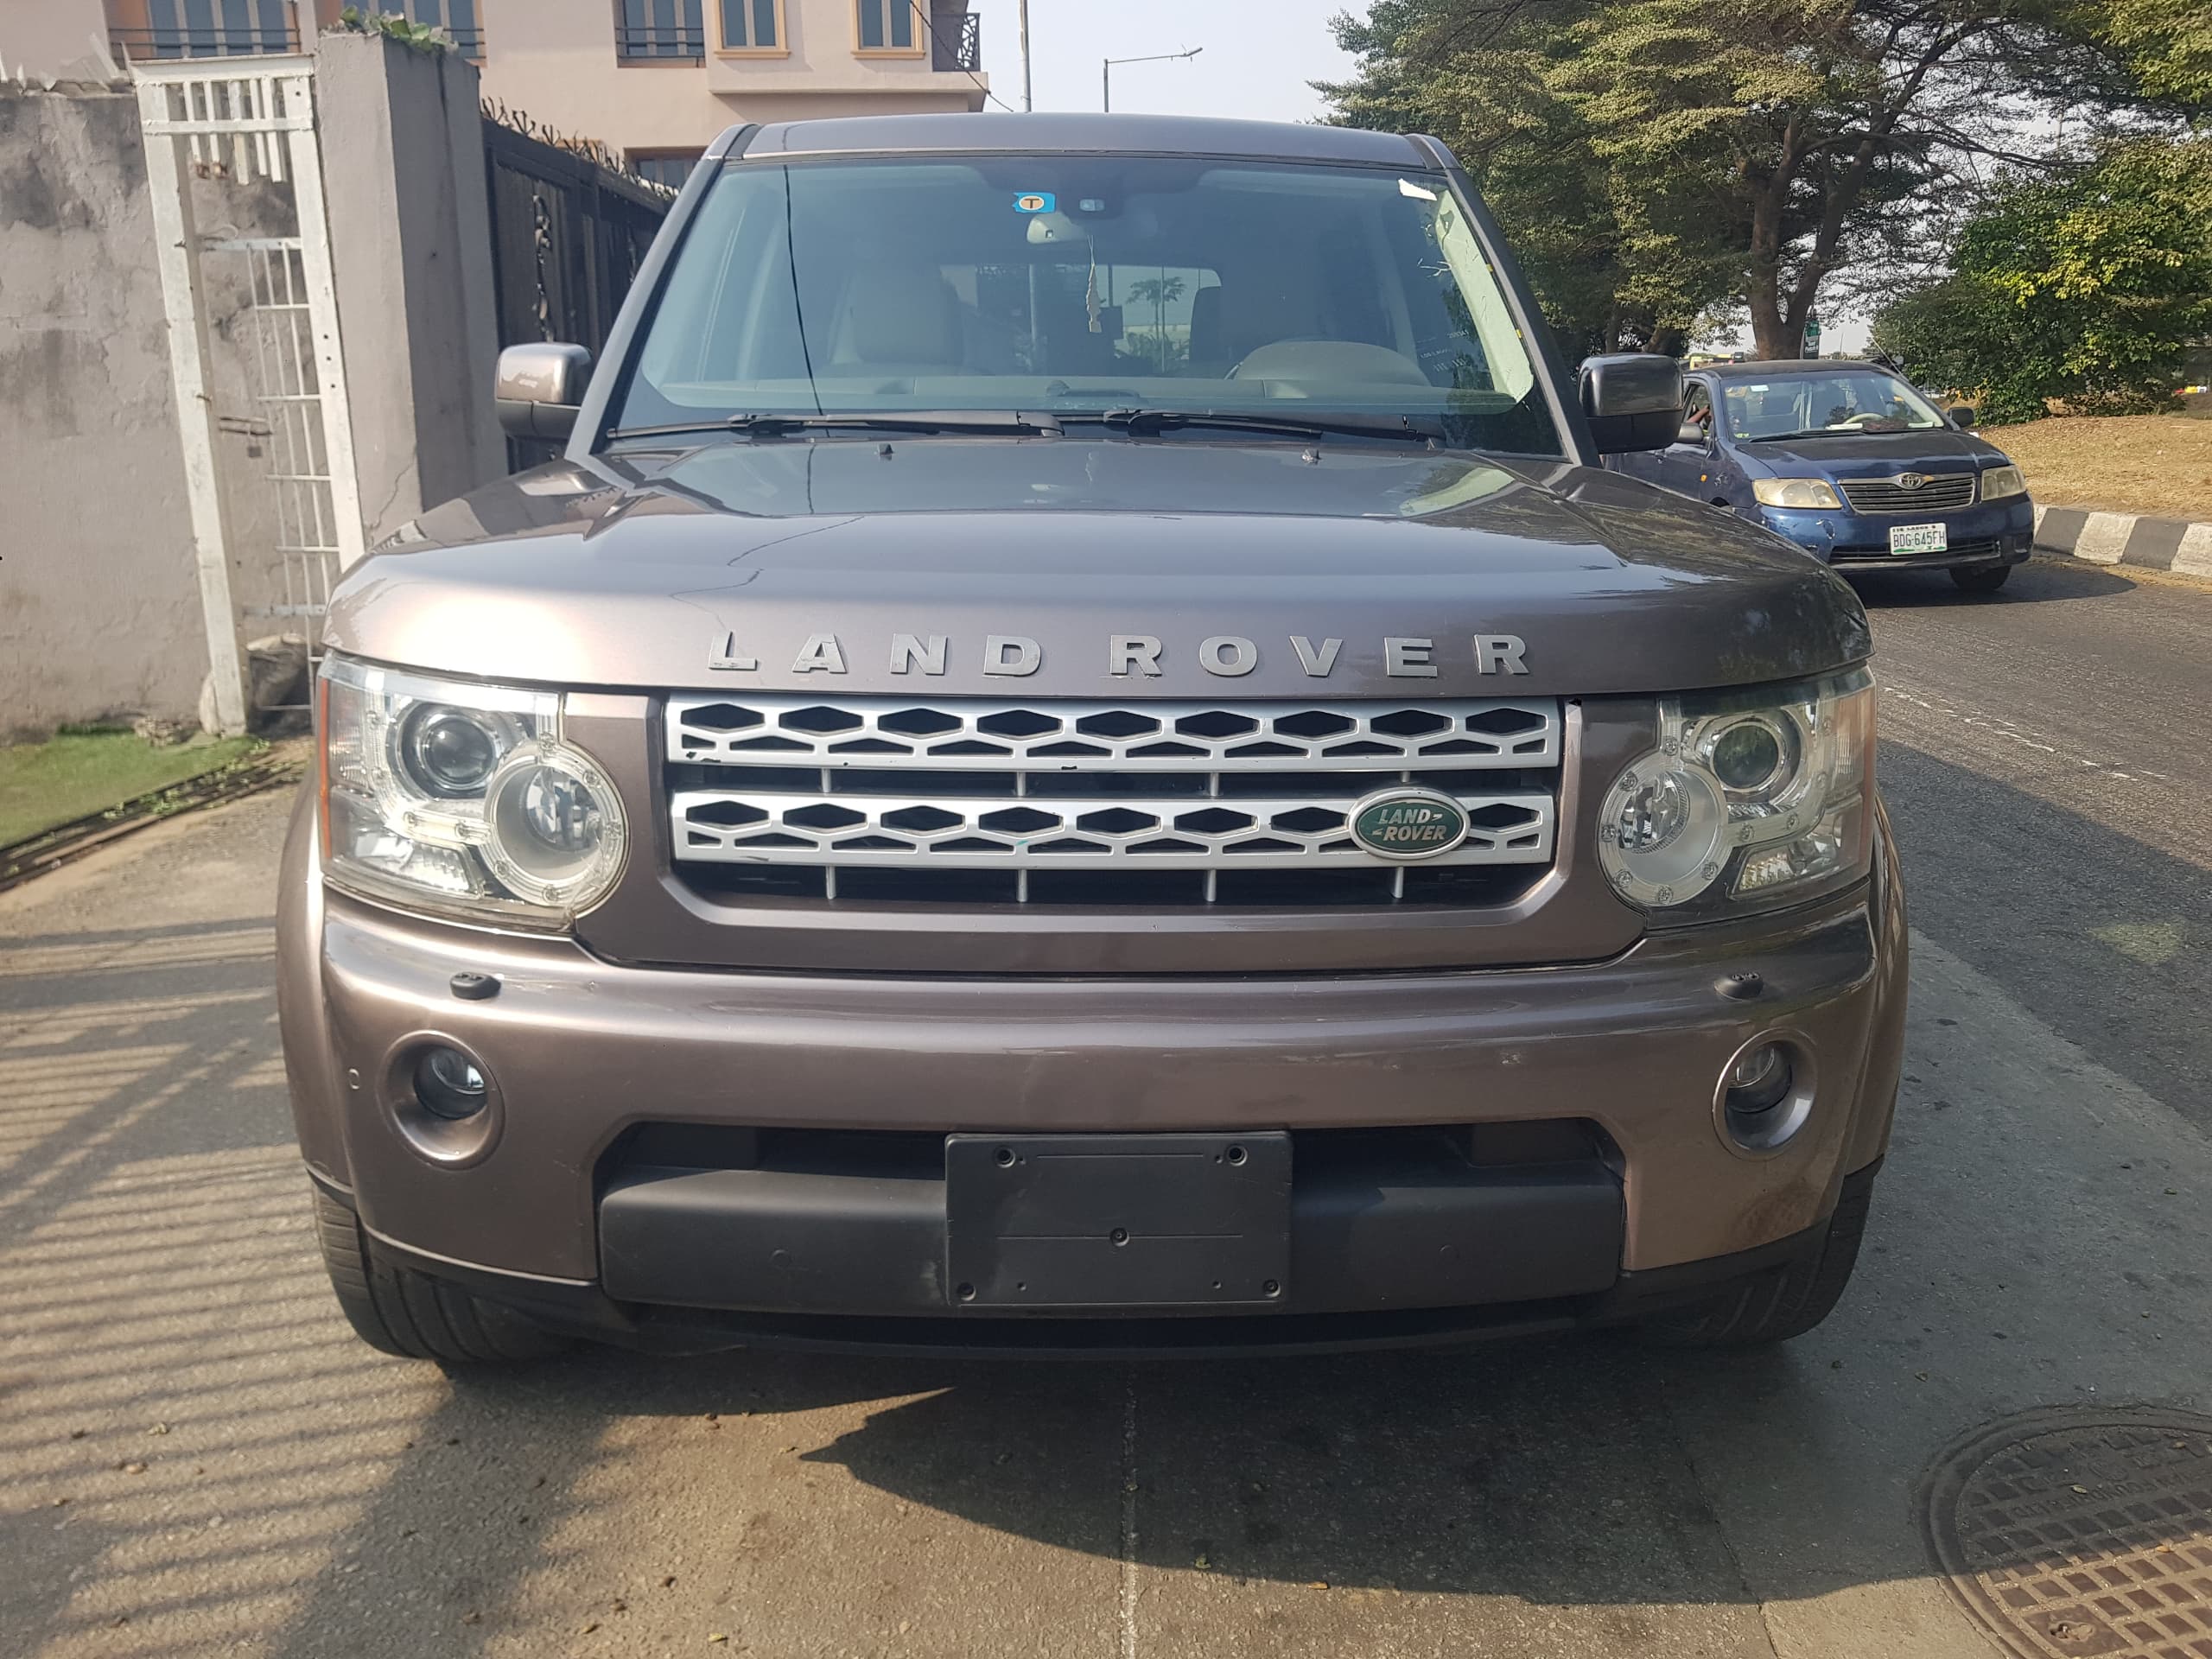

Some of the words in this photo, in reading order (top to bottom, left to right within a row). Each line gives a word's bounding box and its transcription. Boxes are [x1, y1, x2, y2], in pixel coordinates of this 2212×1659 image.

[1024, 198, 1040, 209] T
[1893, 531, 1945, 548] BDG-645FH
[709, 631, 1041, 677] LAND
[1110, 633, 1530, 677] ROVER
